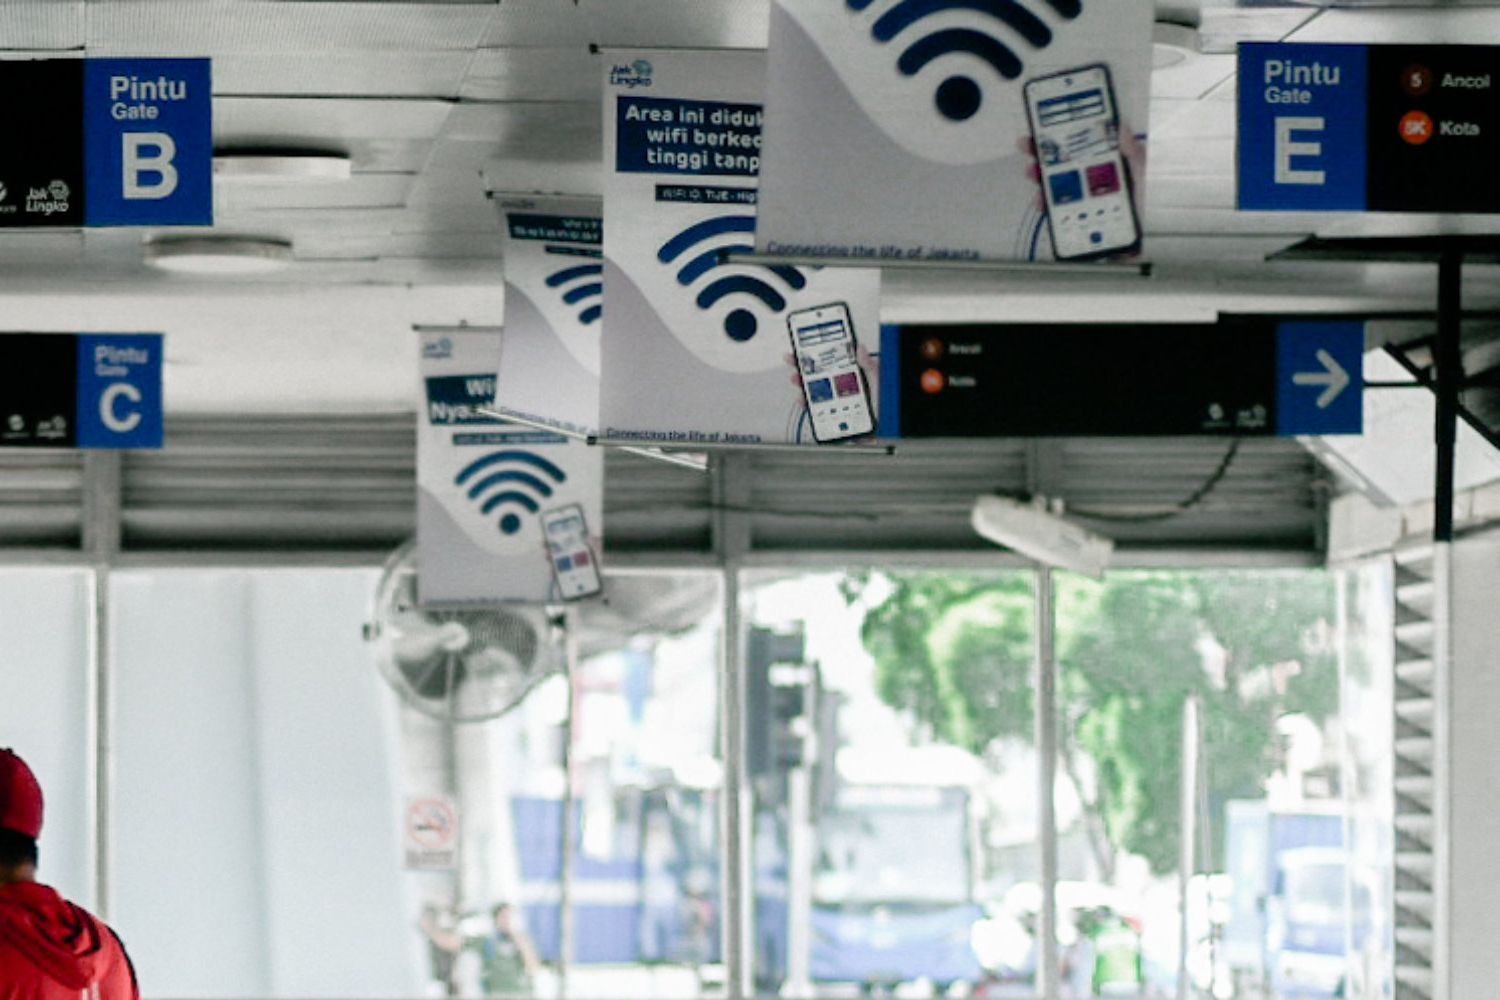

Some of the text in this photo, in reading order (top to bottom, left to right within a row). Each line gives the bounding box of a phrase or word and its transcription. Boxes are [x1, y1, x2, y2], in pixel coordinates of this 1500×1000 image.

[1264, 60, 1340, 85] Pintu
[110, 76, 186, 100] Pintu
[1264, 86, 1312, 103] Gate
[111, 102, 159, 119] Gate
[625, 105, 673, 121] Area
[679, 106, 704, 123] ini
[647, 126, 688, 143] wifi
[1440, 120, 1480, 135] Kota
[647, 146, 708, 169] tinggi
[1274, 116, 1325, 184] E
[122, 132, 178, 200] B
[26, 200, 69, 215] Lingko
[95, 345, 148, 364] Pintu
[100, 382, 142, 433] C
